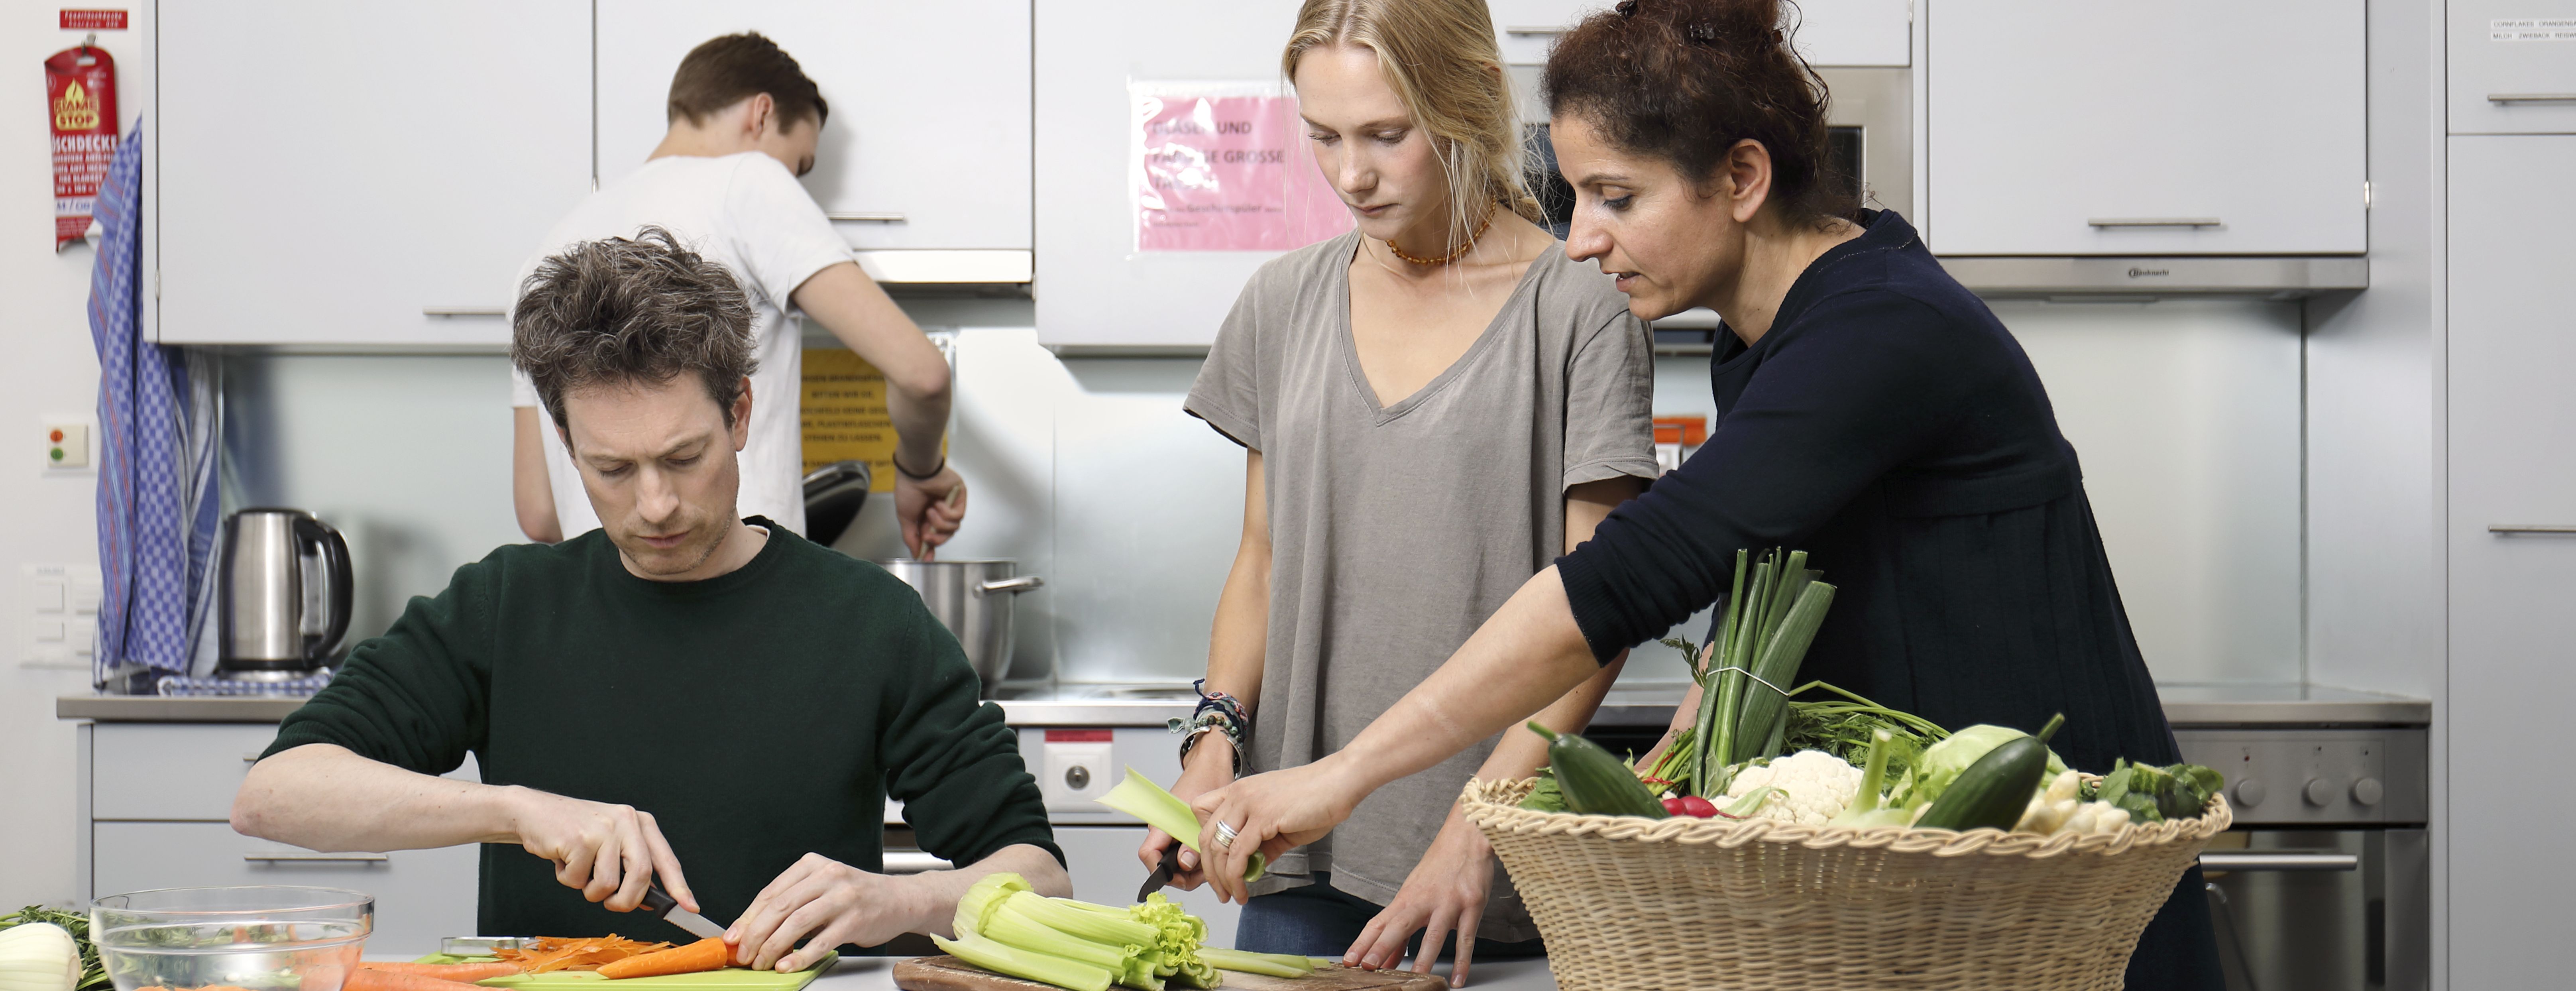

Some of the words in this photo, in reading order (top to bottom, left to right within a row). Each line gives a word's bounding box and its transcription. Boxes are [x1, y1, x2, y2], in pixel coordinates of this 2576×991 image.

[54, 97, 99, 114] FLAME
[60, 114, 94, 127] STOP
[1216, 121, 1252, 134] UND
[1224, 149, 1284, 163] GROSSE
